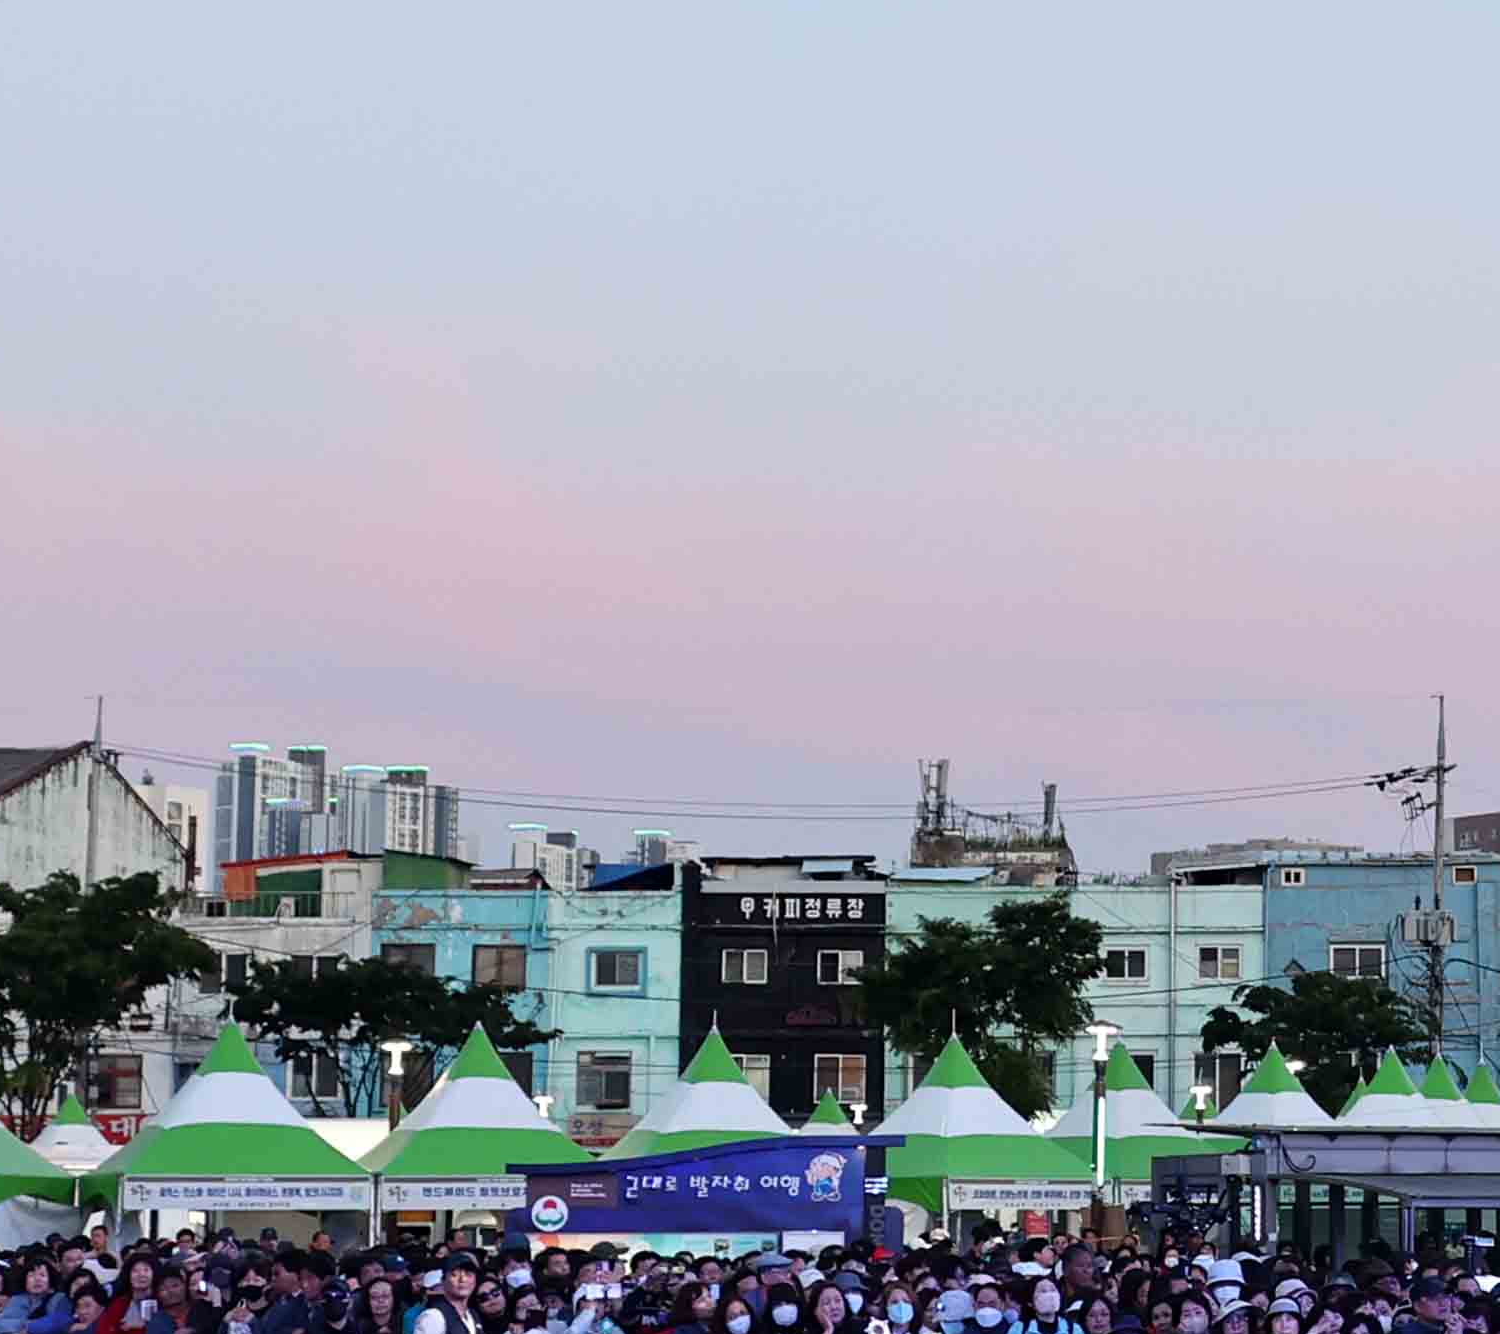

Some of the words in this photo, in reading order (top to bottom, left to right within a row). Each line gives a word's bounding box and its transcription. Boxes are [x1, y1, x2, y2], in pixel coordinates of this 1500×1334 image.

[763, 898, 865, 919] 커피정류장
[689, 1174, 750, 1198] 발자취
[760, 1173, 801, 1196] 여행
